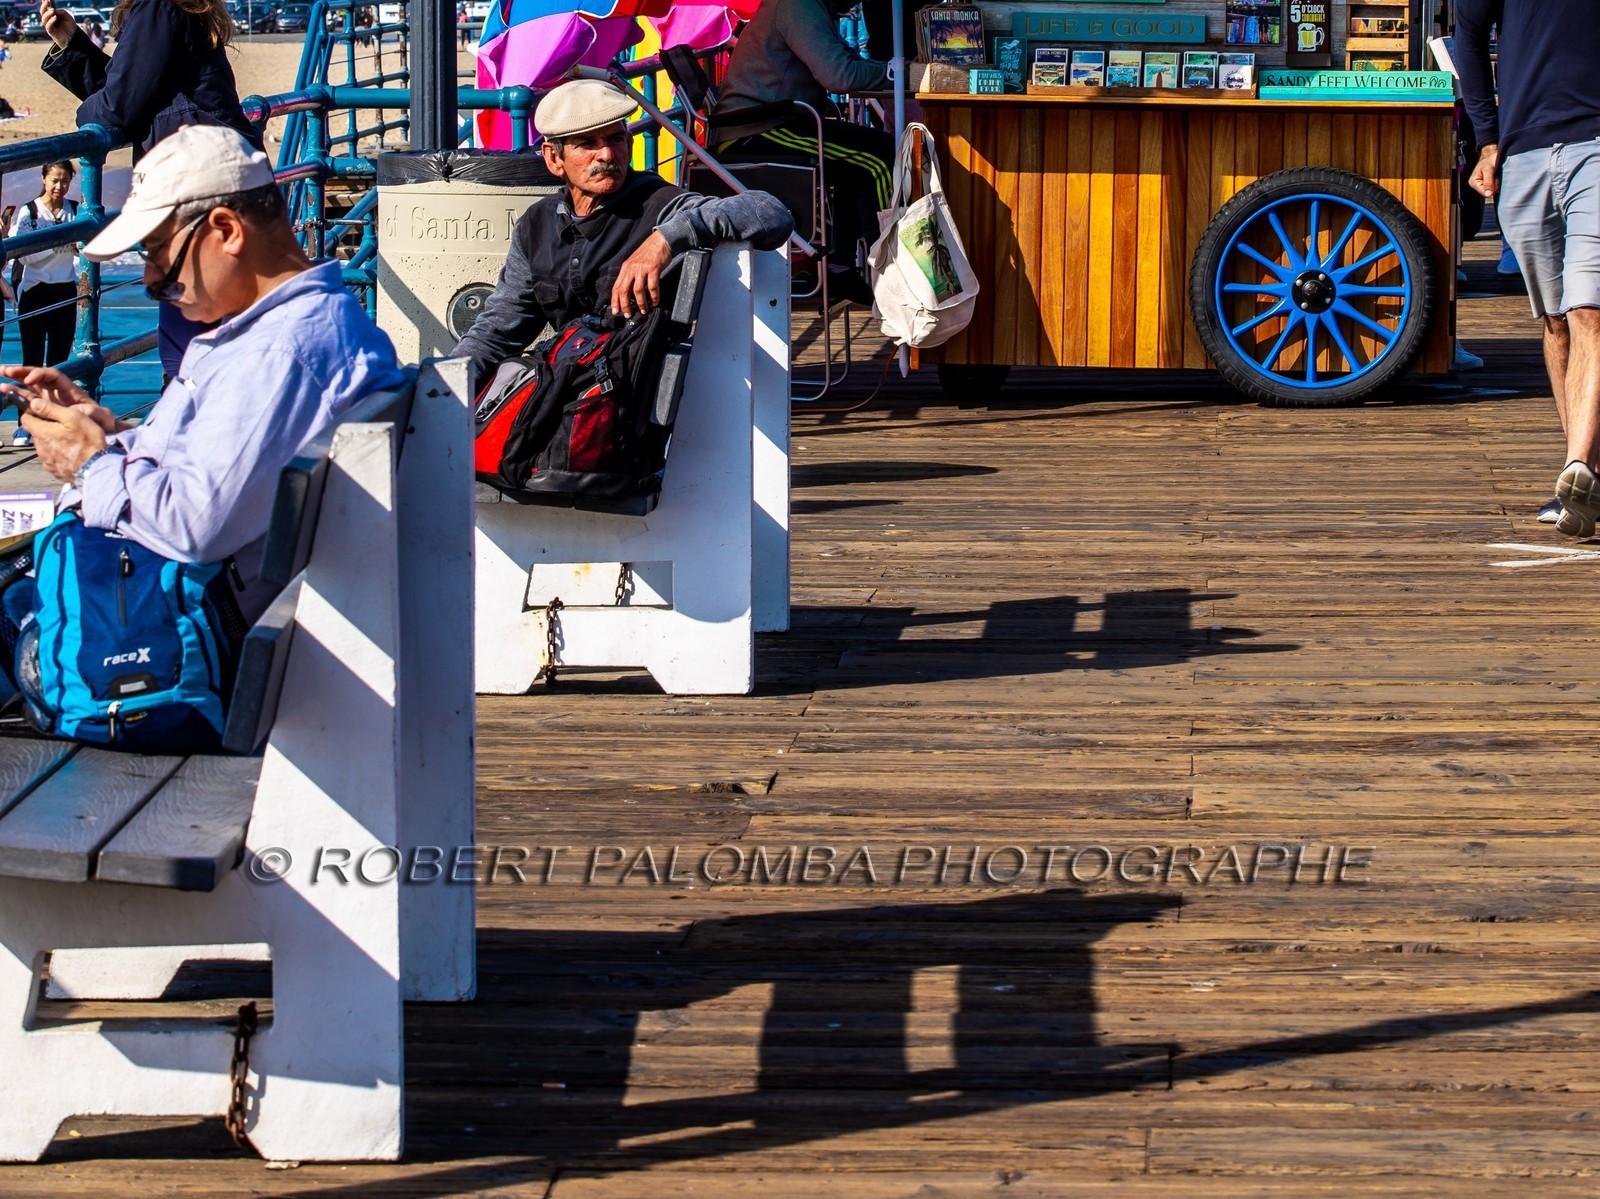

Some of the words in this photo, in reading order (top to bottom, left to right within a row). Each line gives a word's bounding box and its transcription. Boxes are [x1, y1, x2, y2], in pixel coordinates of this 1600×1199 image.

[931, 11, 951, 21] SANTA
[953, 11, 979, 21] MONICA
[1290, 4, 1302, 23] 5
[1024, 16, 1079, 37] LIFE
[1112, 17, 1196, 38] GOOD
[1266, 74, 1314, 88] SANDY
[1318, 74, 1351, 88] FEET
[1354, 75, 1428, 88] WELCOME
[411, 205, 496, 242] Santa
